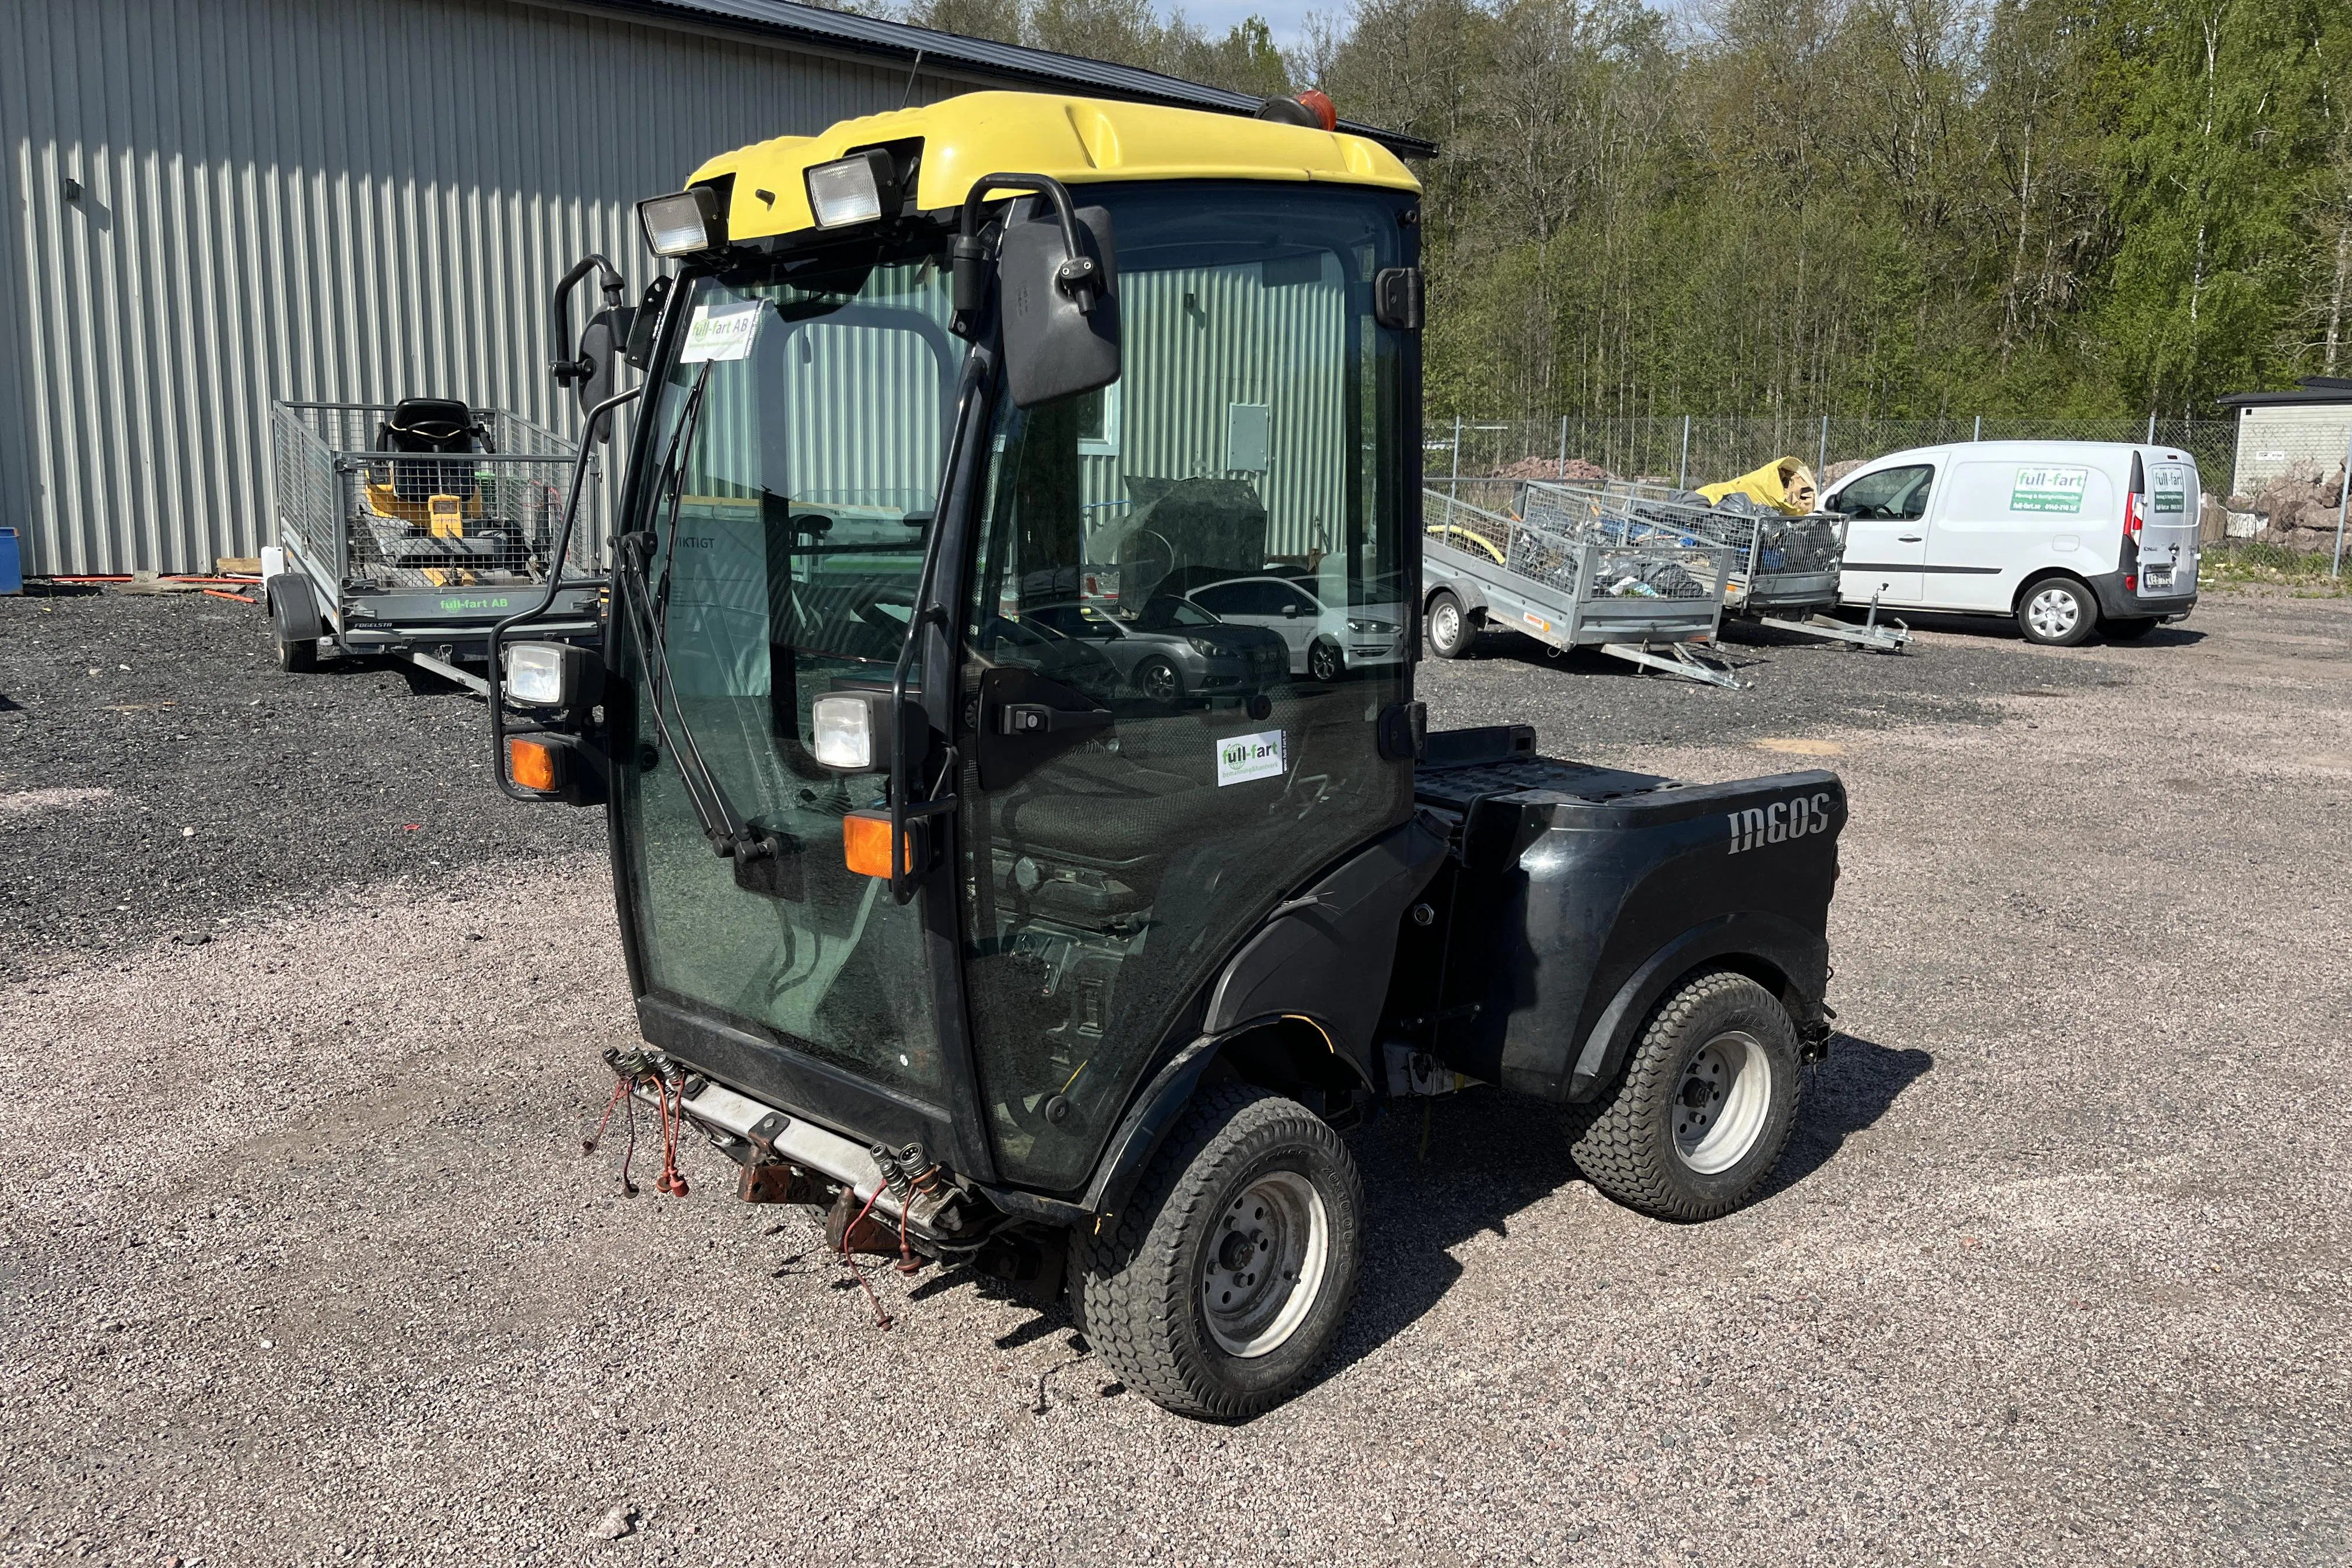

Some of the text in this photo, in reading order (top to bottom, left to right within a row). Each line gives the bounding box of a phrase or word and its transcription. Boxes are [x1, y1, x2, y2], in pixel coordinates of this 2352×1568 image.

[692, 318, 748, 337] full-fart AB
[2019, 472, 2083, 487] full-fart
[440, 598, 508, 610] full-fart AB
[1223, 741, 1278, 765] full-fart
